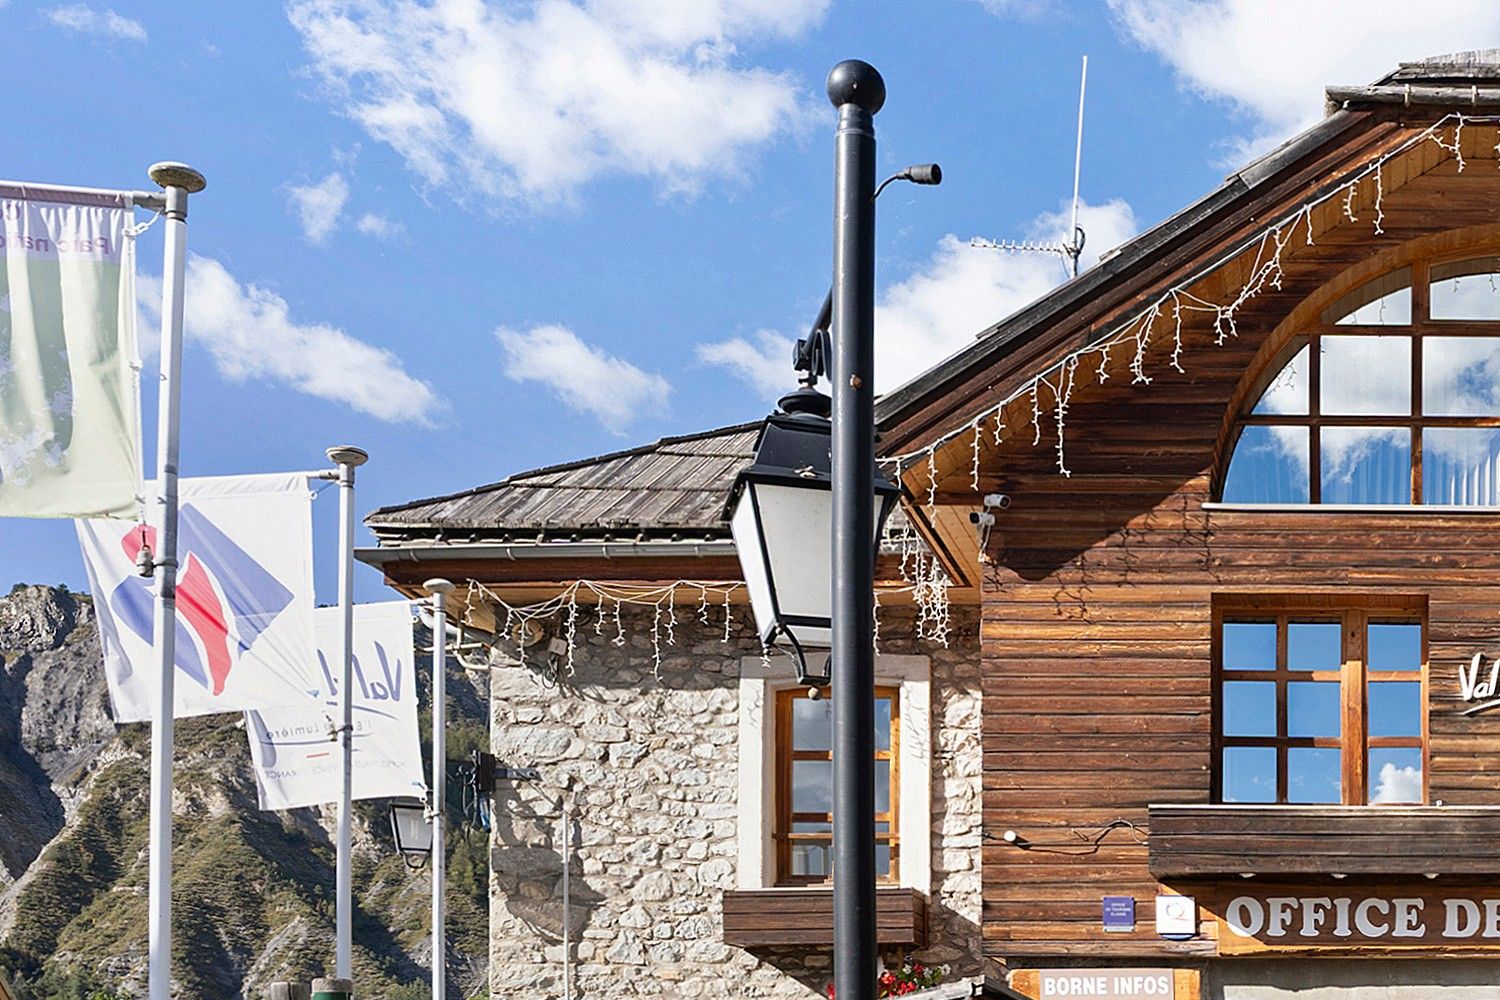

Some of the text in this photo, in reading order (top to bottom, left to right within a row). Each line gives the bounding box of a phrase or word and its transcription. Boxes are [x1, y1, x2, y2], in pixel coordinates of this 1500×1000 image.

[1459, 653, 1500, 700] Val
[1225, 896, 1426, 938] OFFICE
[1044, 976, 1169, 996] BORNE INFOS
